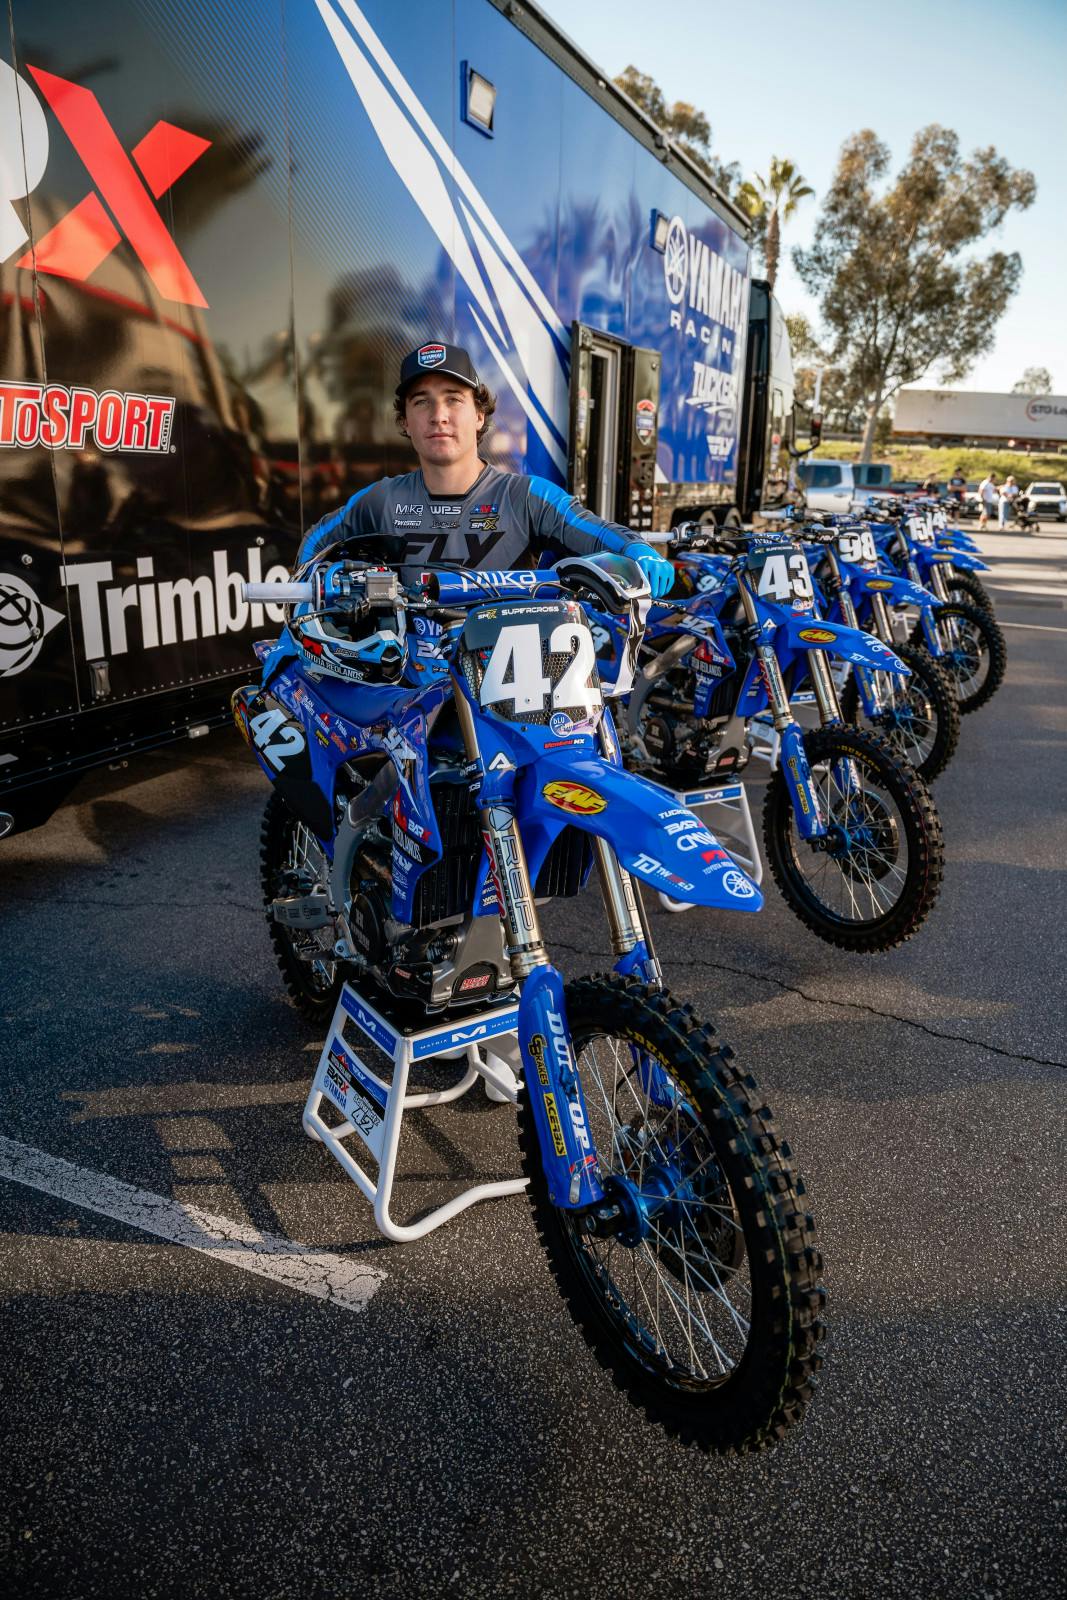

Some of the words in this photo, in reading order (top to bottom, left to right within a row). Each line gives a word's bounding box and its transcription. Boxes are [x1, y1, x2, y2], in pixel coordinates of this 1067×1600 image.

[688, 233, 748, 340] YAMAHA
[670, 309, 741, 359] RACING
[430, 505, 462, 515] WPS
[839, 531, 878, 562] 98
[757, 554, 815, 600] 43
[501, 606, 559, 615] SUPERCROSS
[304, 649, 325, 667] TOYOTA
[326, 663, 364, 681] REDLANDS
[480, 623, 602, 714] 42
[249, 709, 306, 773] 42
[543, 783, 608, 809] FMF
[501, 834, 535, 933] REP
[420, 1038, 448, 1050] MATRIX
[328, 1079, 347, 1111] YAMAHA
[546, 1010, 591, 1149] DUOP
[351, 1107, 374, 1137] 42
